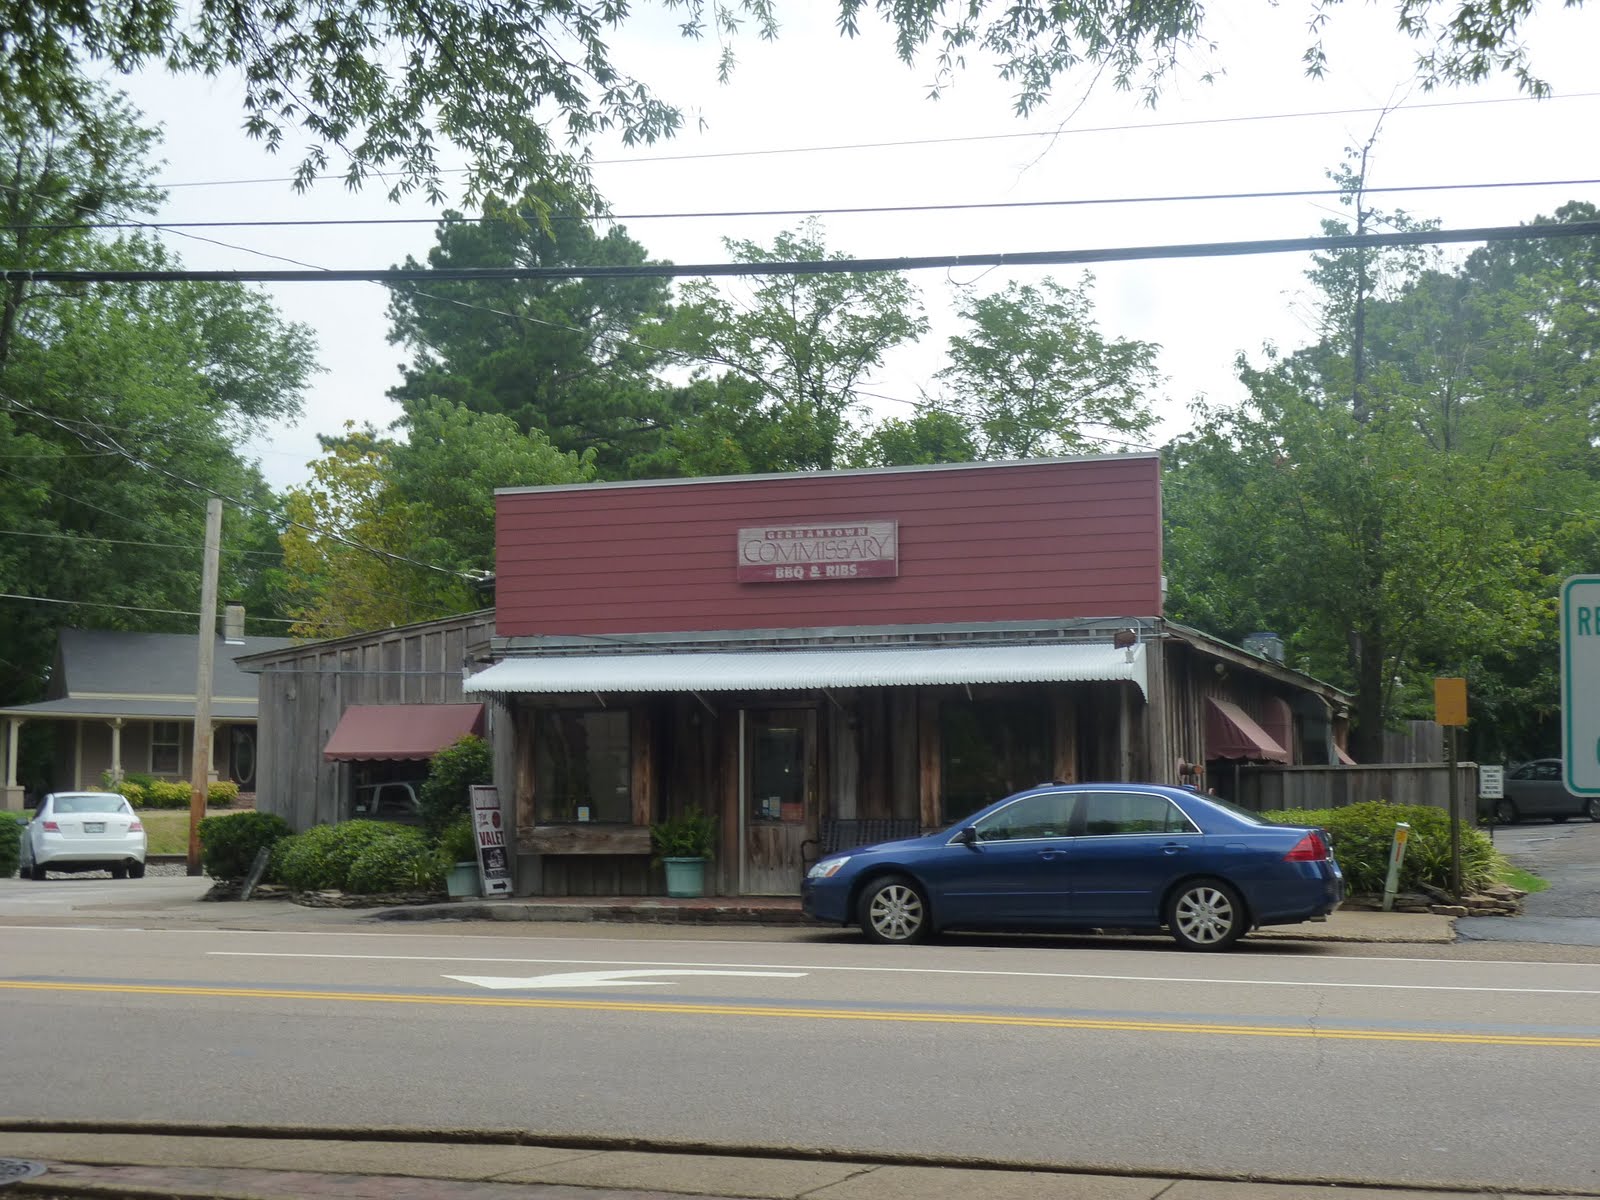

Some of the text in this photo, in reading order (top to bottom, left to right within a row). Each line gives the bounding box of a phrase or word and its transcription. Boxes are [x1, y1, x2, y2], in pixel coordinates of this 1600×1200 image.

[767, 527, 866, 539] GERMANTOWN
[743, 535, 891, 563] COMMISSARY
[775, 564, 858, 579] BBQ & RIBS
[479, 830, 505, 846] VALET
